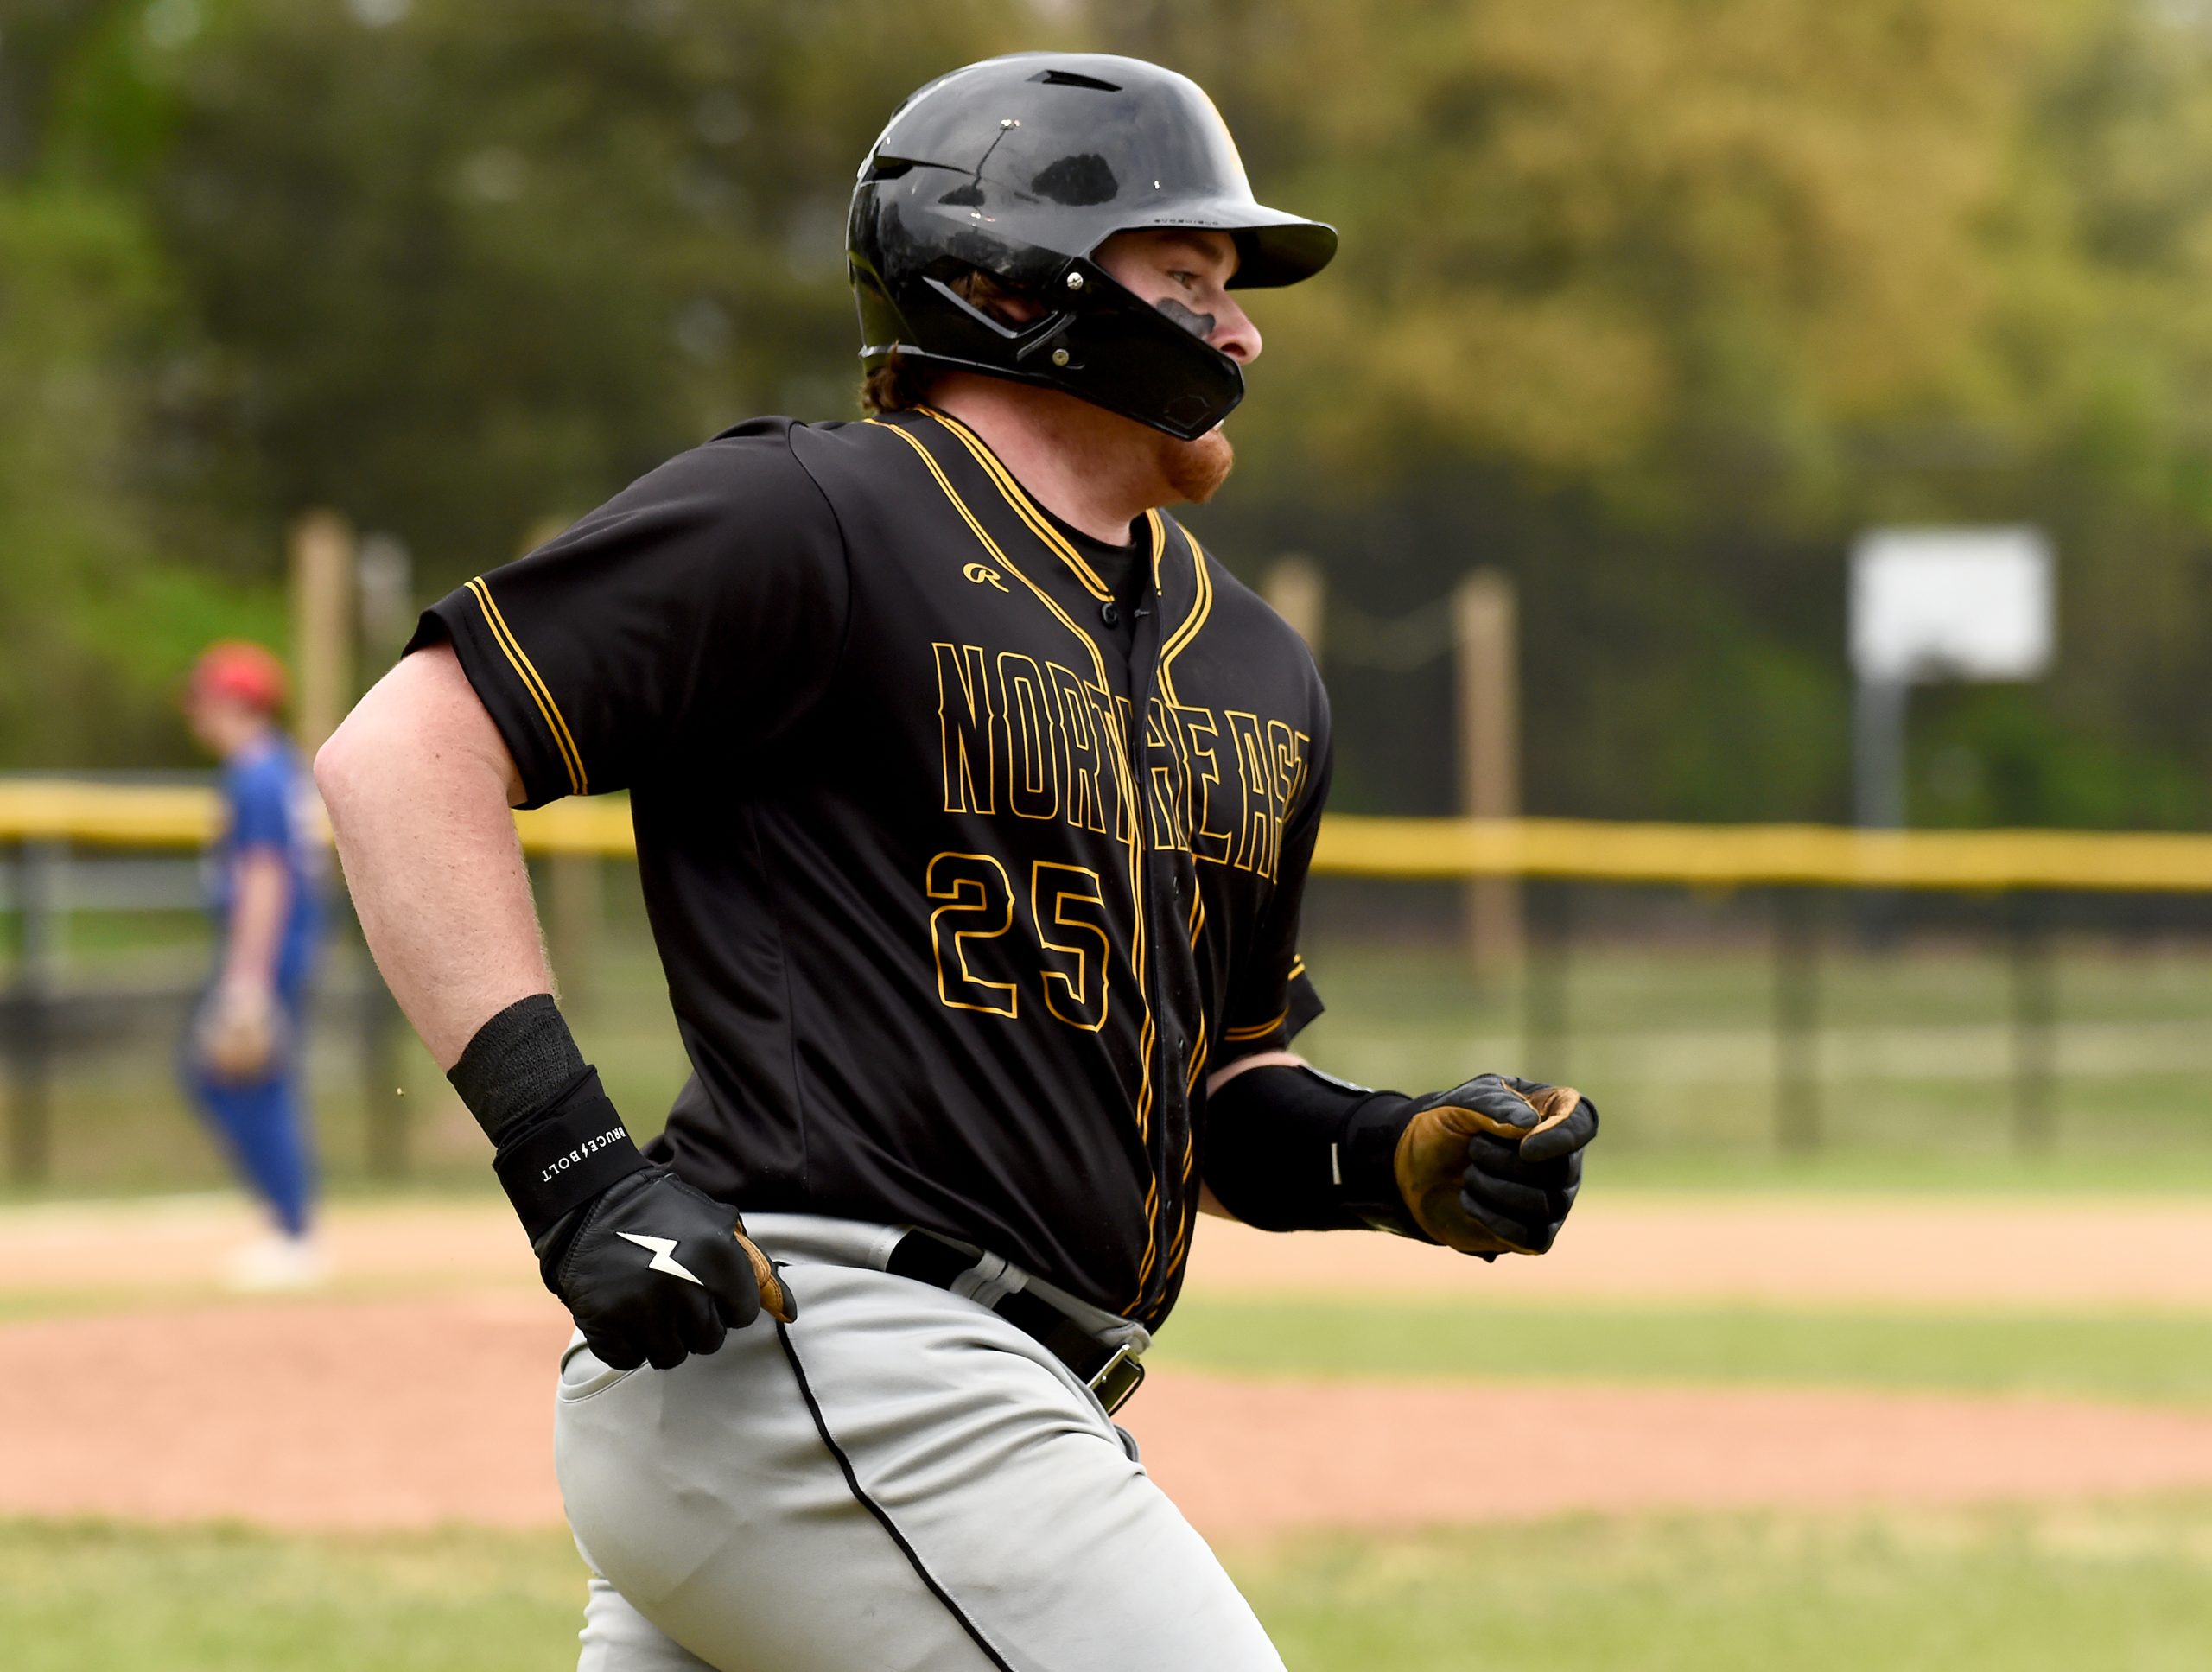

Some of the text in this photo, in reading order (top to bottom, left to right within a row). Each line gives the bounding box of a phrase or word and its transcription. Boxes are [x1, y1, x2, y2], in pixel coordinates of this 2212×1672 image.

[926, 851, 1109, 1033] 25
[542, 1127, 626, 1182] BRUCE BOLT
